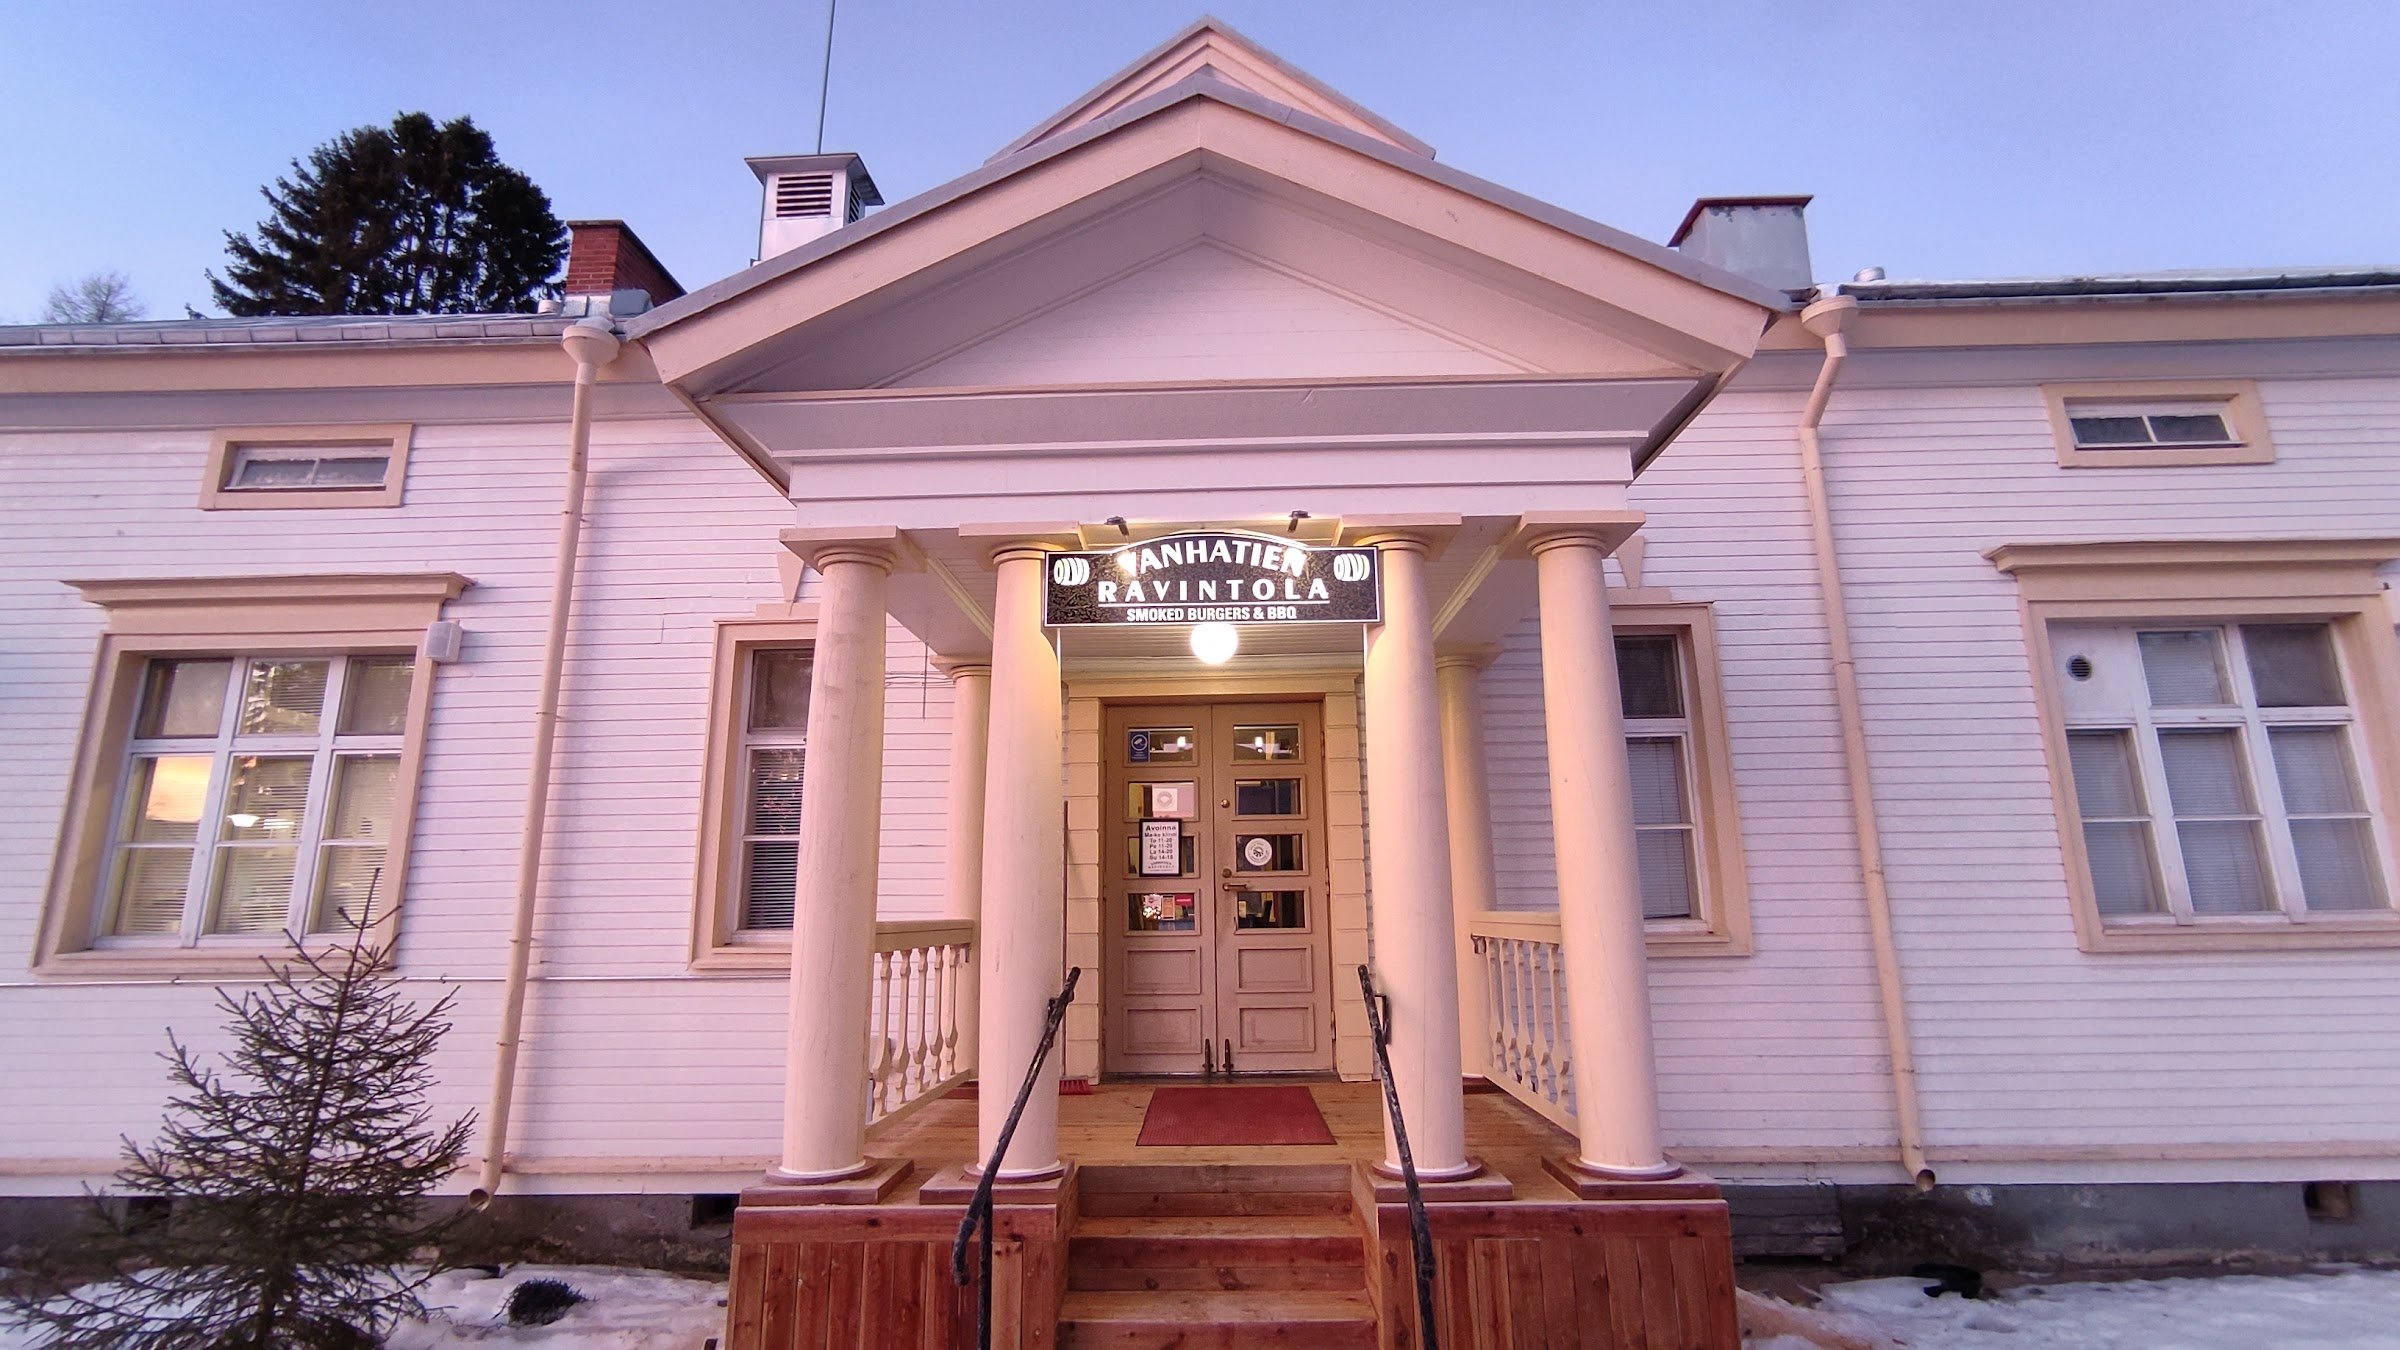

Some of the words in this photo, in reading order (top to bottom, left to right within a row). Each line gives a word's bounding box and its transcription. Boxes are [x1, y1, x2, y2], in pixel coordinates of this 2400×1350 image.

[1098, 578, 1330, 603] RAVINTOLA
[1127, 608, 1184, 622] SMOKED
[1187, 607, 1250, 621] BURGERS
[1252, 606, 1265, 620] &
[1267, 605, 1298, 620] BBQ
